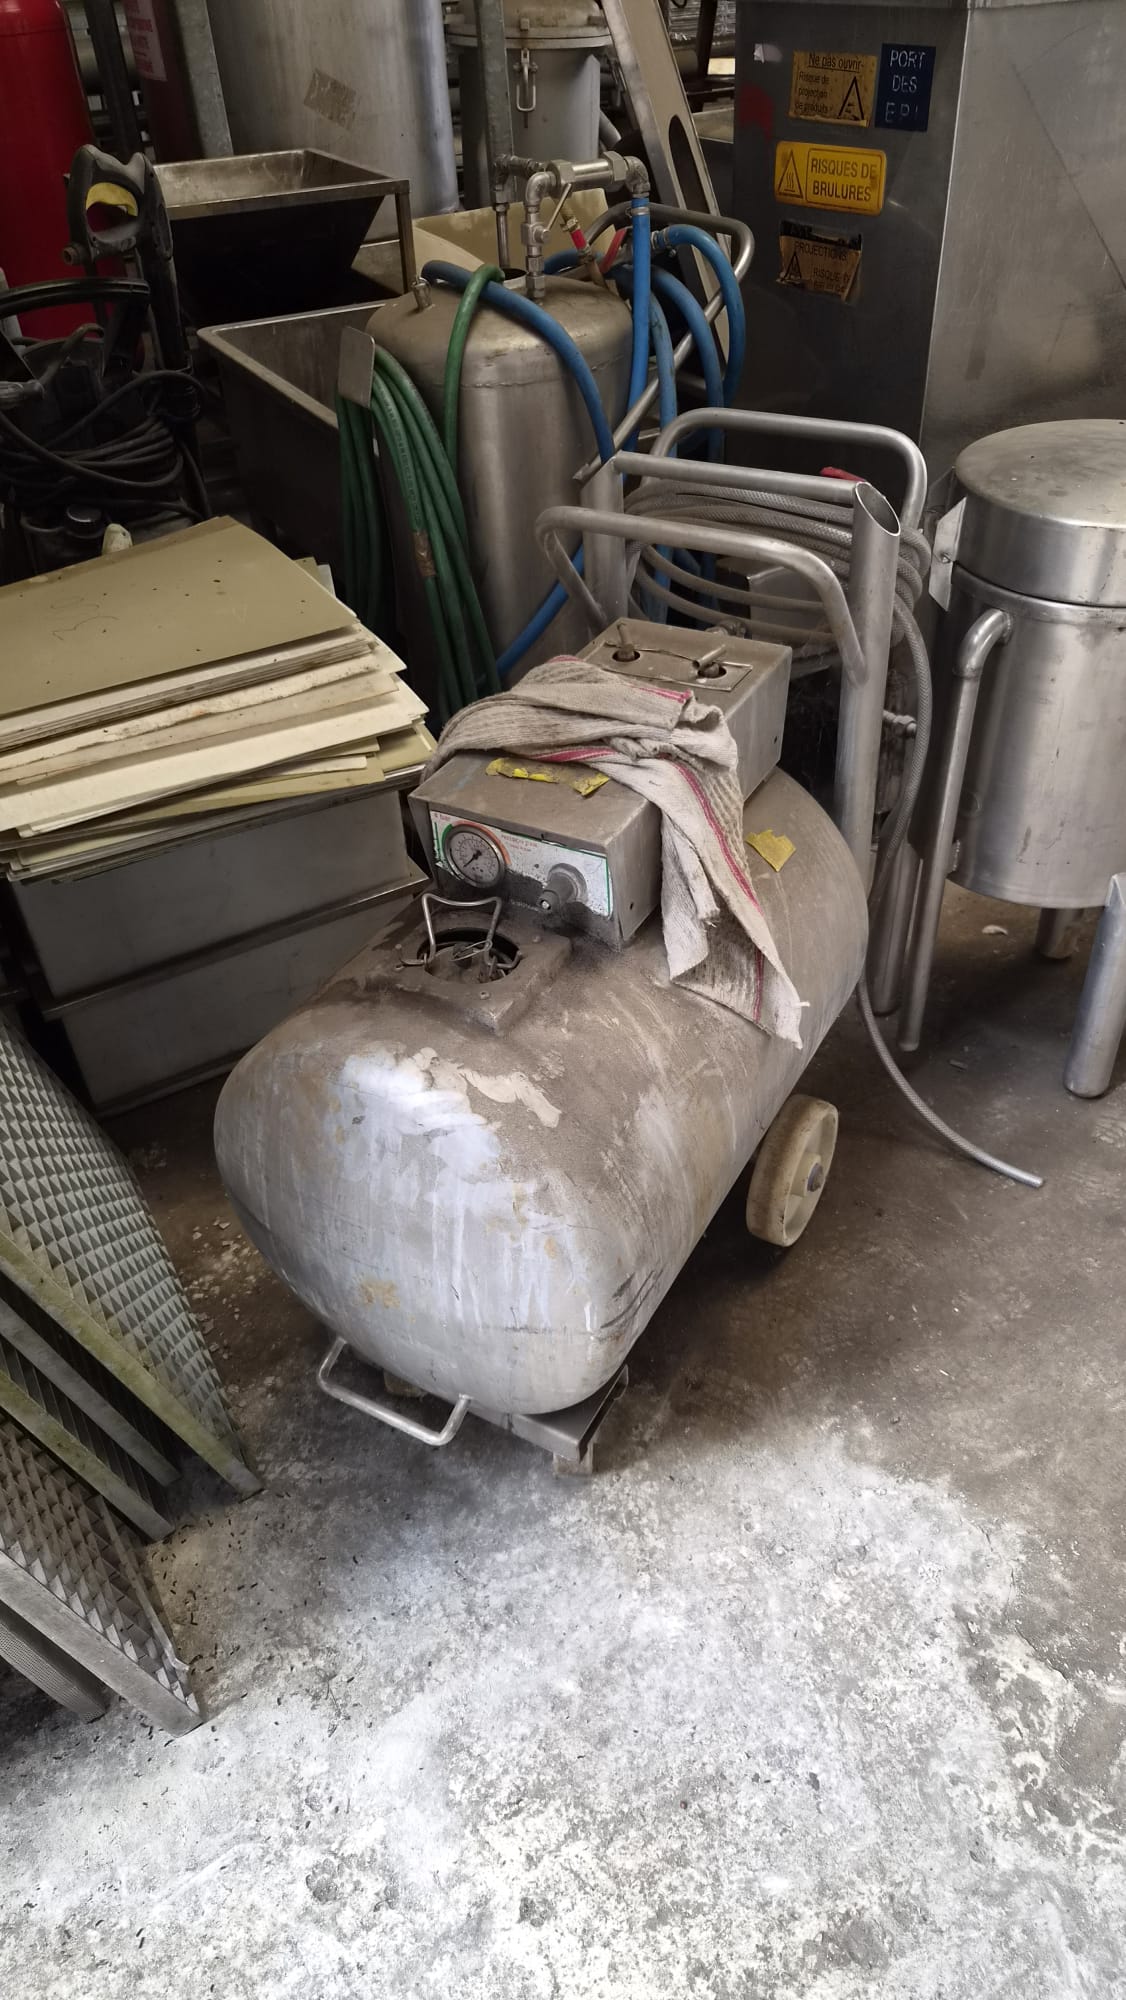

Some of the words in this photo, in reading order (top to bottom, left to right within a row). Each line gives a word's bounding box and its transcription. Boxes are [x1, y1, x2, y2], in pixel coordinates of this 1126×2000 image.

[808, 52, 820, 66] Ne
[822, 56, 836, 68] pas
[889, 49, 926, 70] PORT
[892, 74, 918, 93] DES
[811, 158, 858, 178] RISQUES
[861, 163, 877, 180] DE
[812, 180, 872, 201] BRULURES
